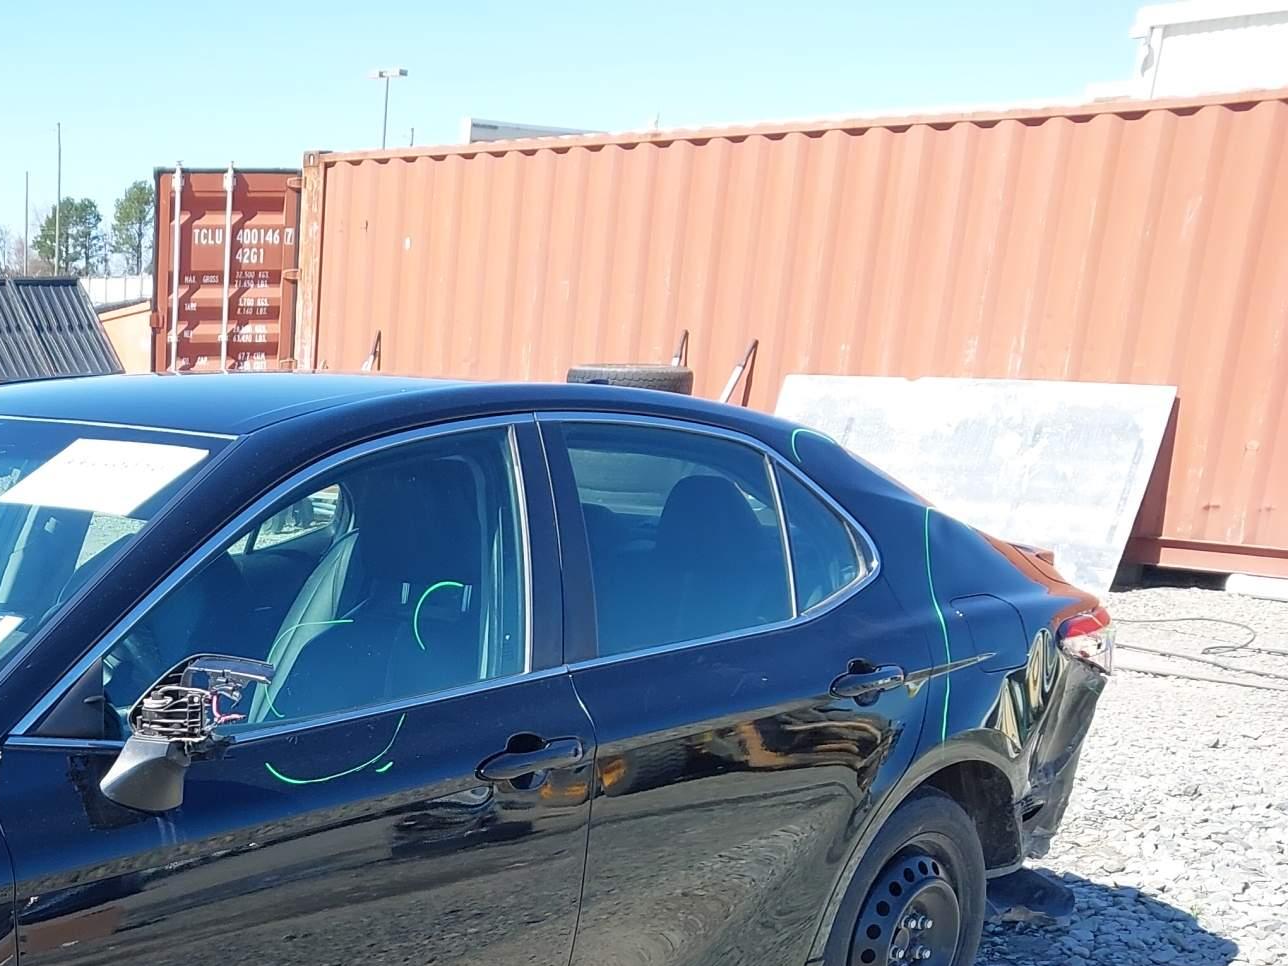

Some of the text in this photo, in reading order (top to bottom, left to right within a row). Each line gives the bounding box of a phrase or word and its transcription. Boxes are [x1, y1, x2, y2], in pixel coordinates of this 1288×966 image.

[193, 228, 223, 245] TCLU
[236, 228, 280, 245] 400146
[235, 247, 264, 264] 42G1
